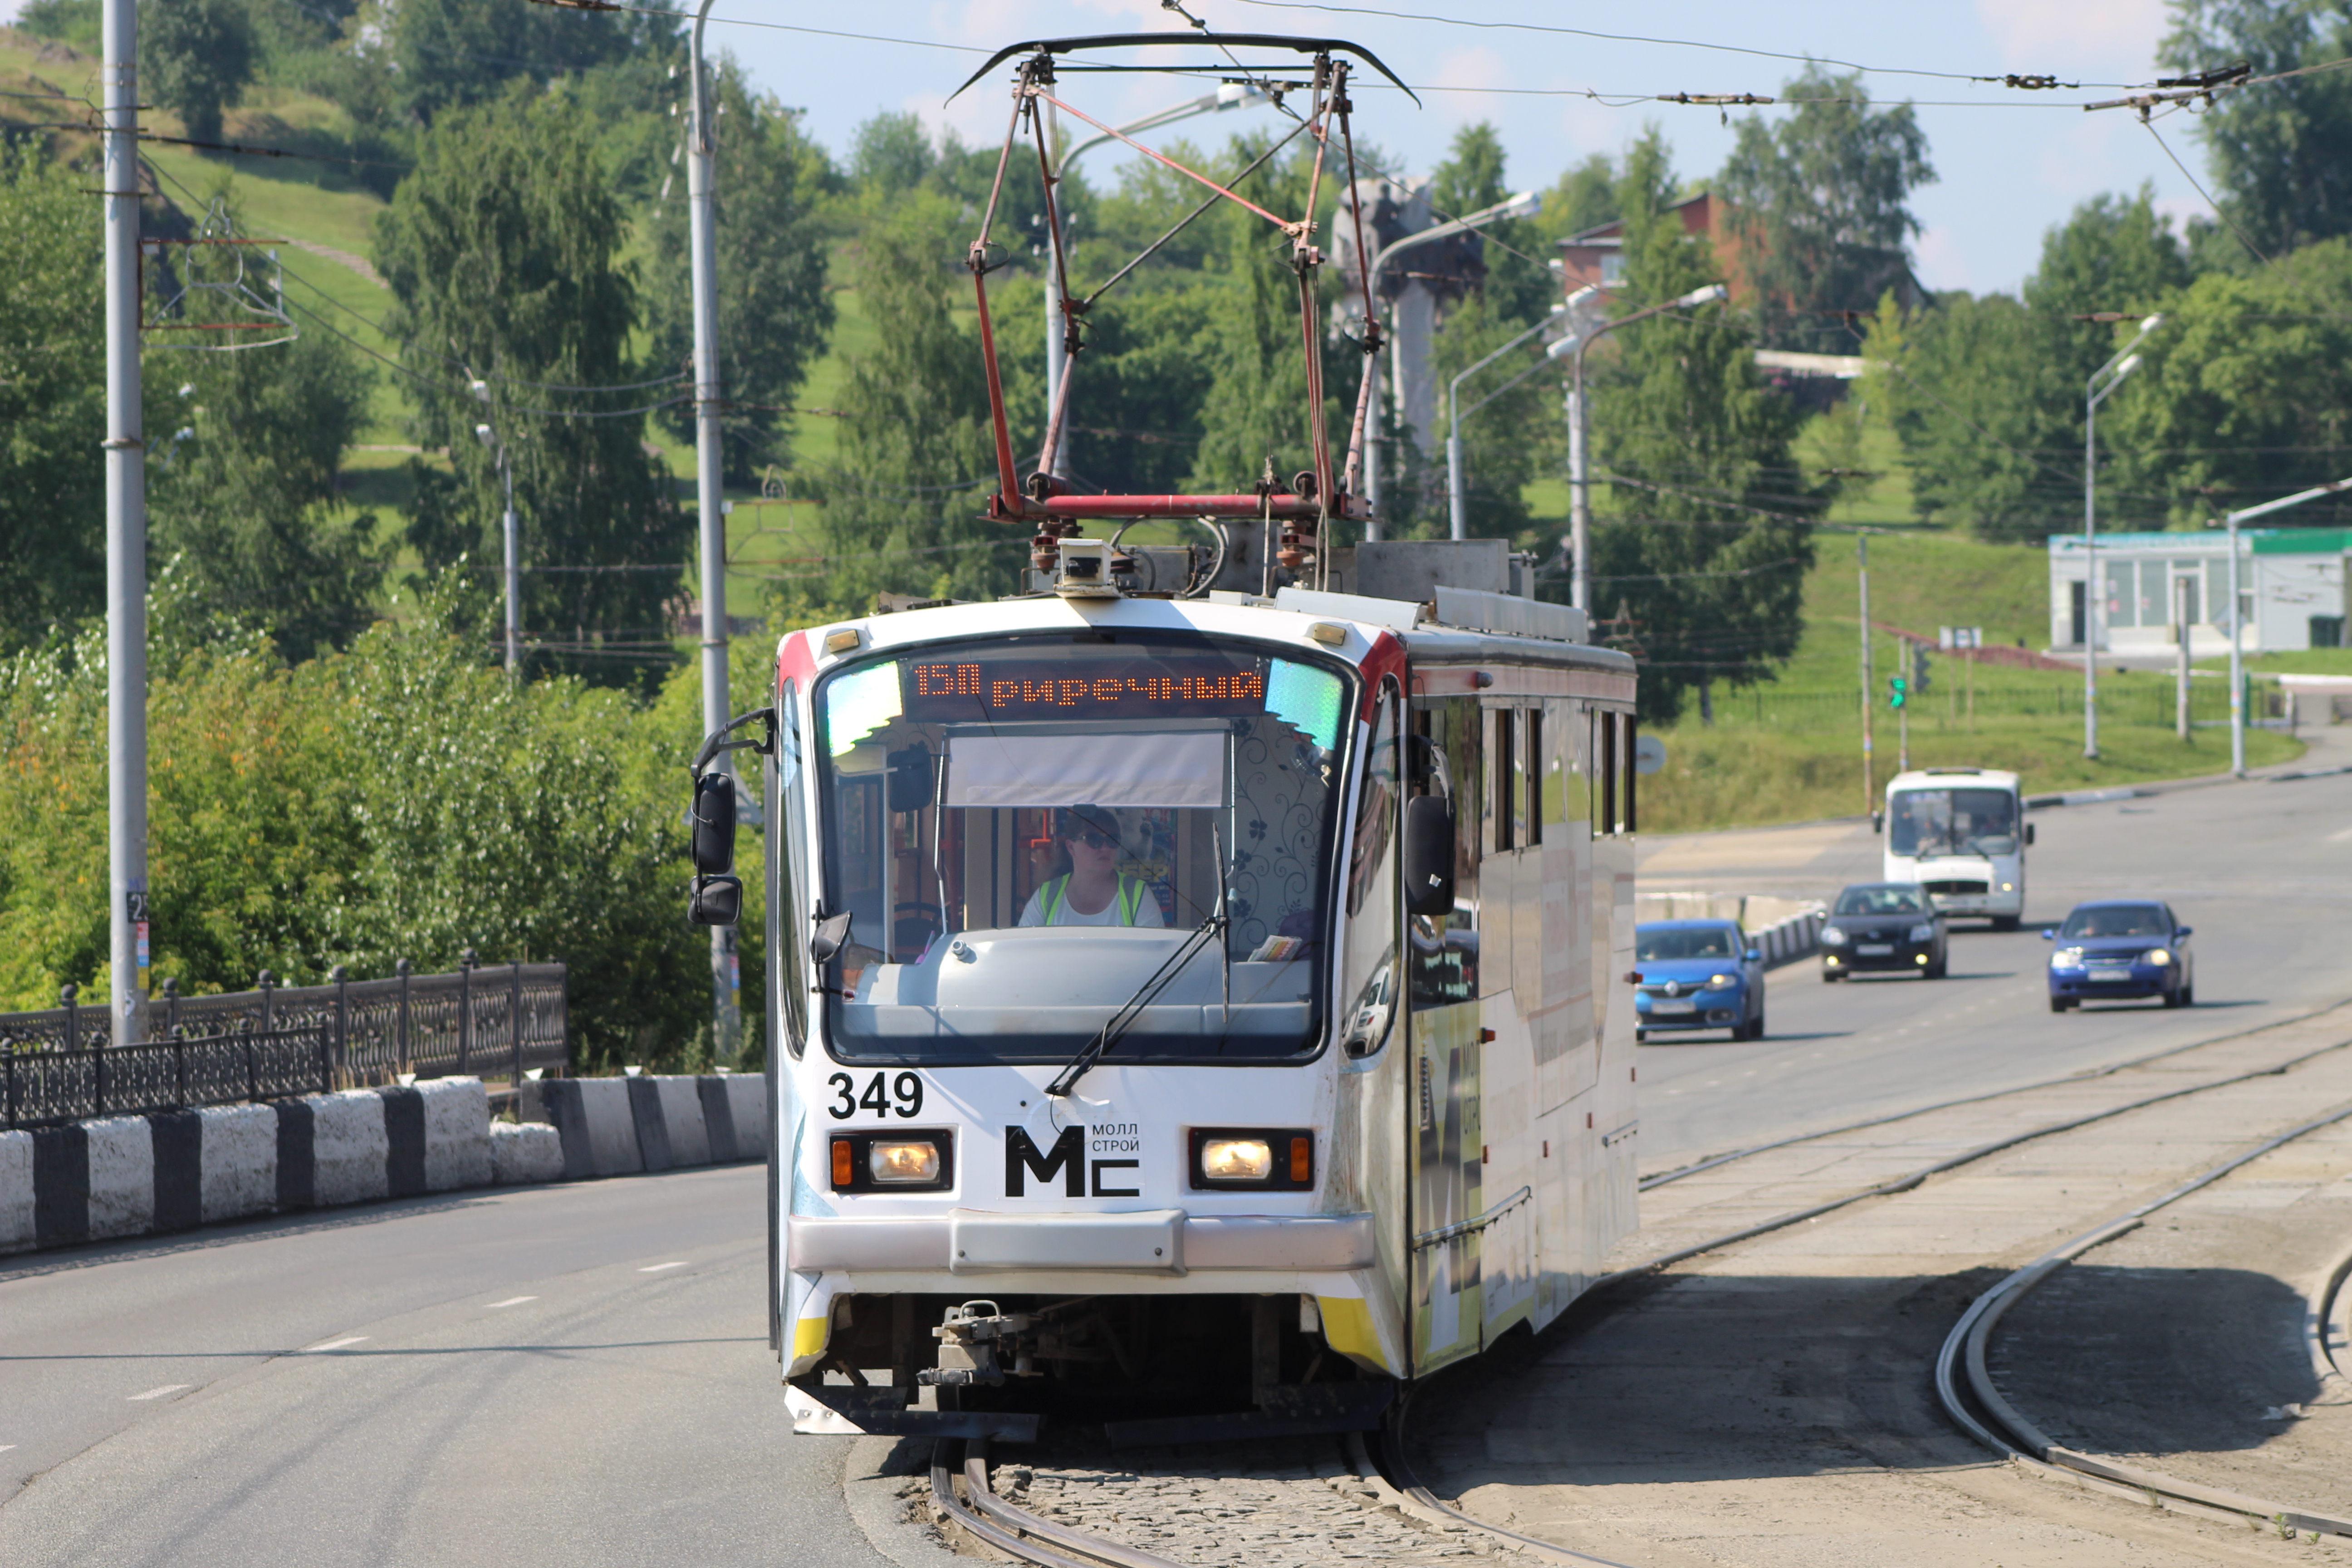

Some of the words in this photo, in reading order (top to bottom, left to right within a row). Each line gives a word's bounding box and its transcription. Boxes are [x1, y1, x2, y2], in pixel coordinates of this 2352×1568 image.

[828, 1071, 923, 1119] 349
[1092, 1124, 1137, 1135] МОЛЛ
[1092, 1137, 1139, 1152] СТРОЙ
